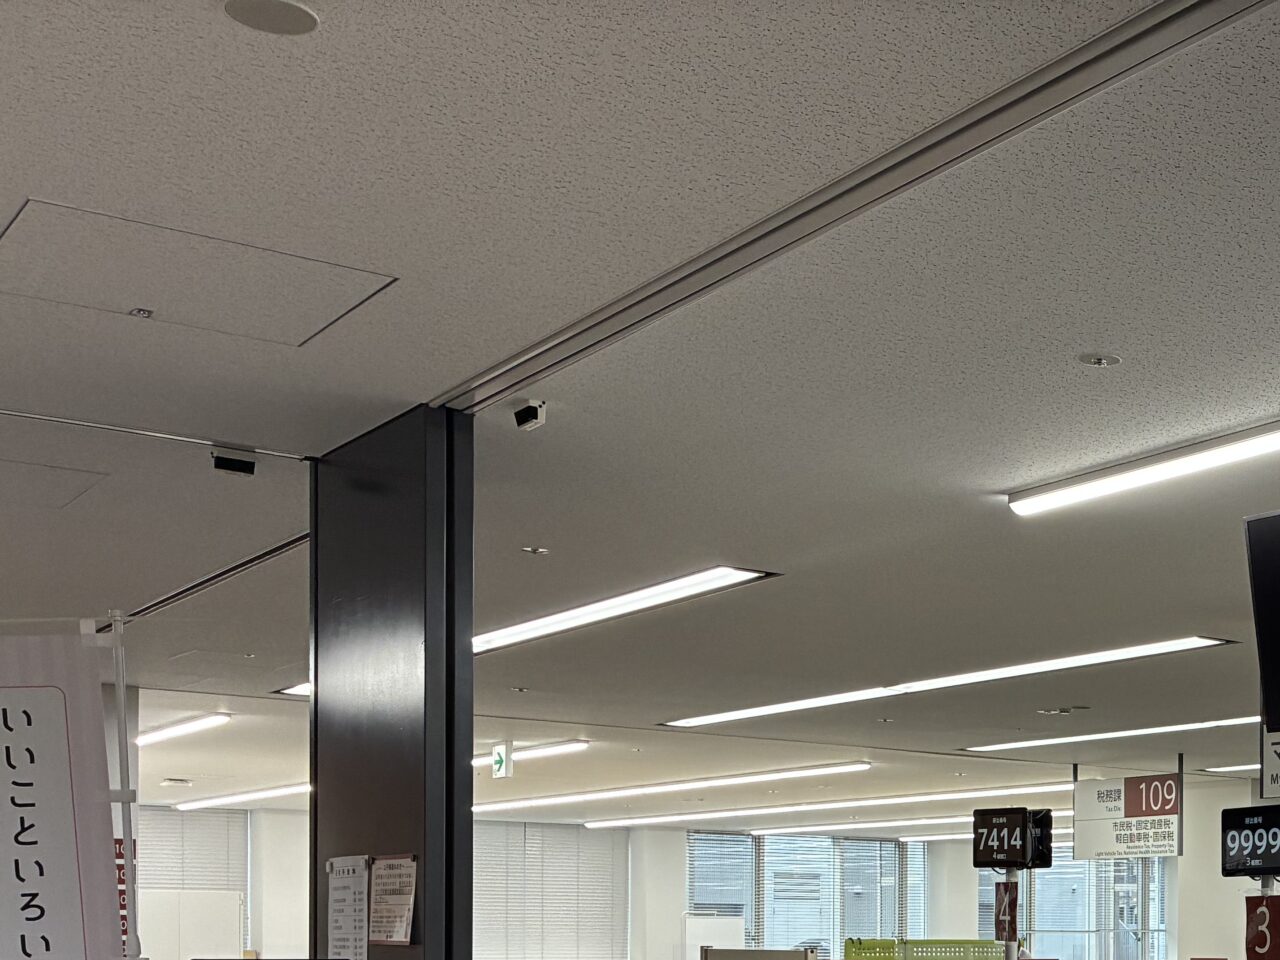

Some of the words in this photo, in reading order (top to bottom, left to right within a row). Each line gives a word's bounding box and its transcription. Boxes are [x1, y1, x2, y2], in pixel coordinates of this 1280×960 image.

[1140, 780, 1176, 811] 109
[978, 827, 1022, 850] 7414
[1255, 906, 1271, 954] 3
